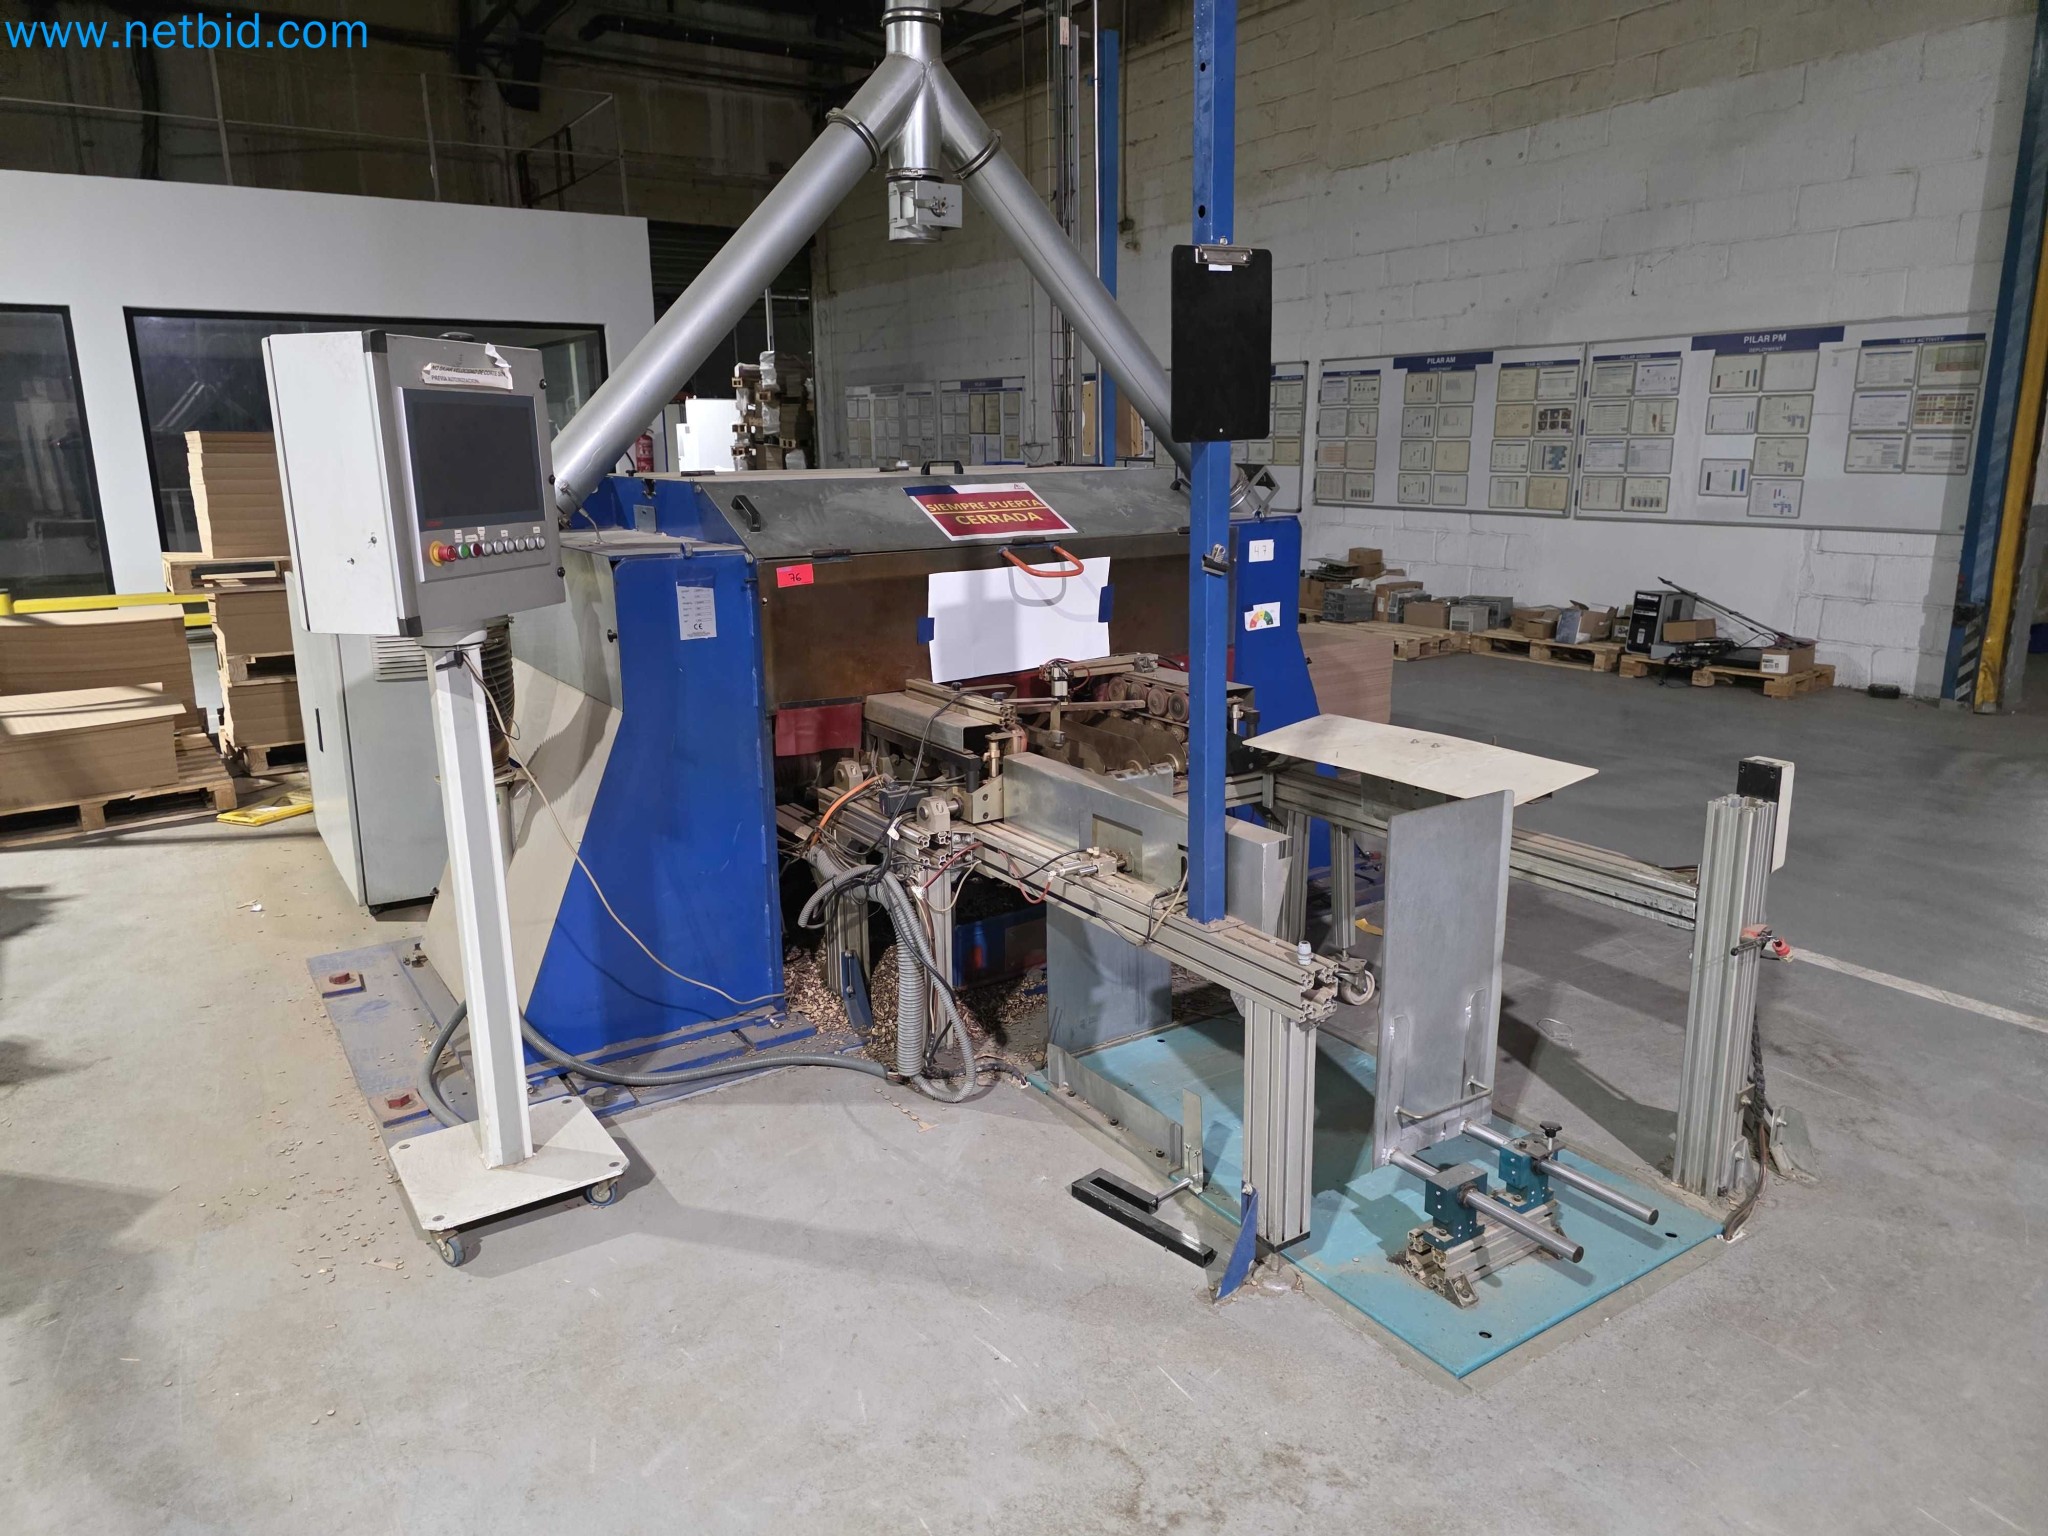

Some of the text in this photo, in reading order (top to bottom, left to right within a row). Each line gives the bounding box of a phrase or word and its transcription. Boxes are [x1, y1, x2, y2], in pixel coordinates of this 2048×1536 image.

[1743, 333, 1787, 344] PILAR PM
[925, 498, 1043, 513] SIEMPRE PUERTA
[955, 512, 1043, 526] CERRADA
[788, 572, 802, 582] 76
